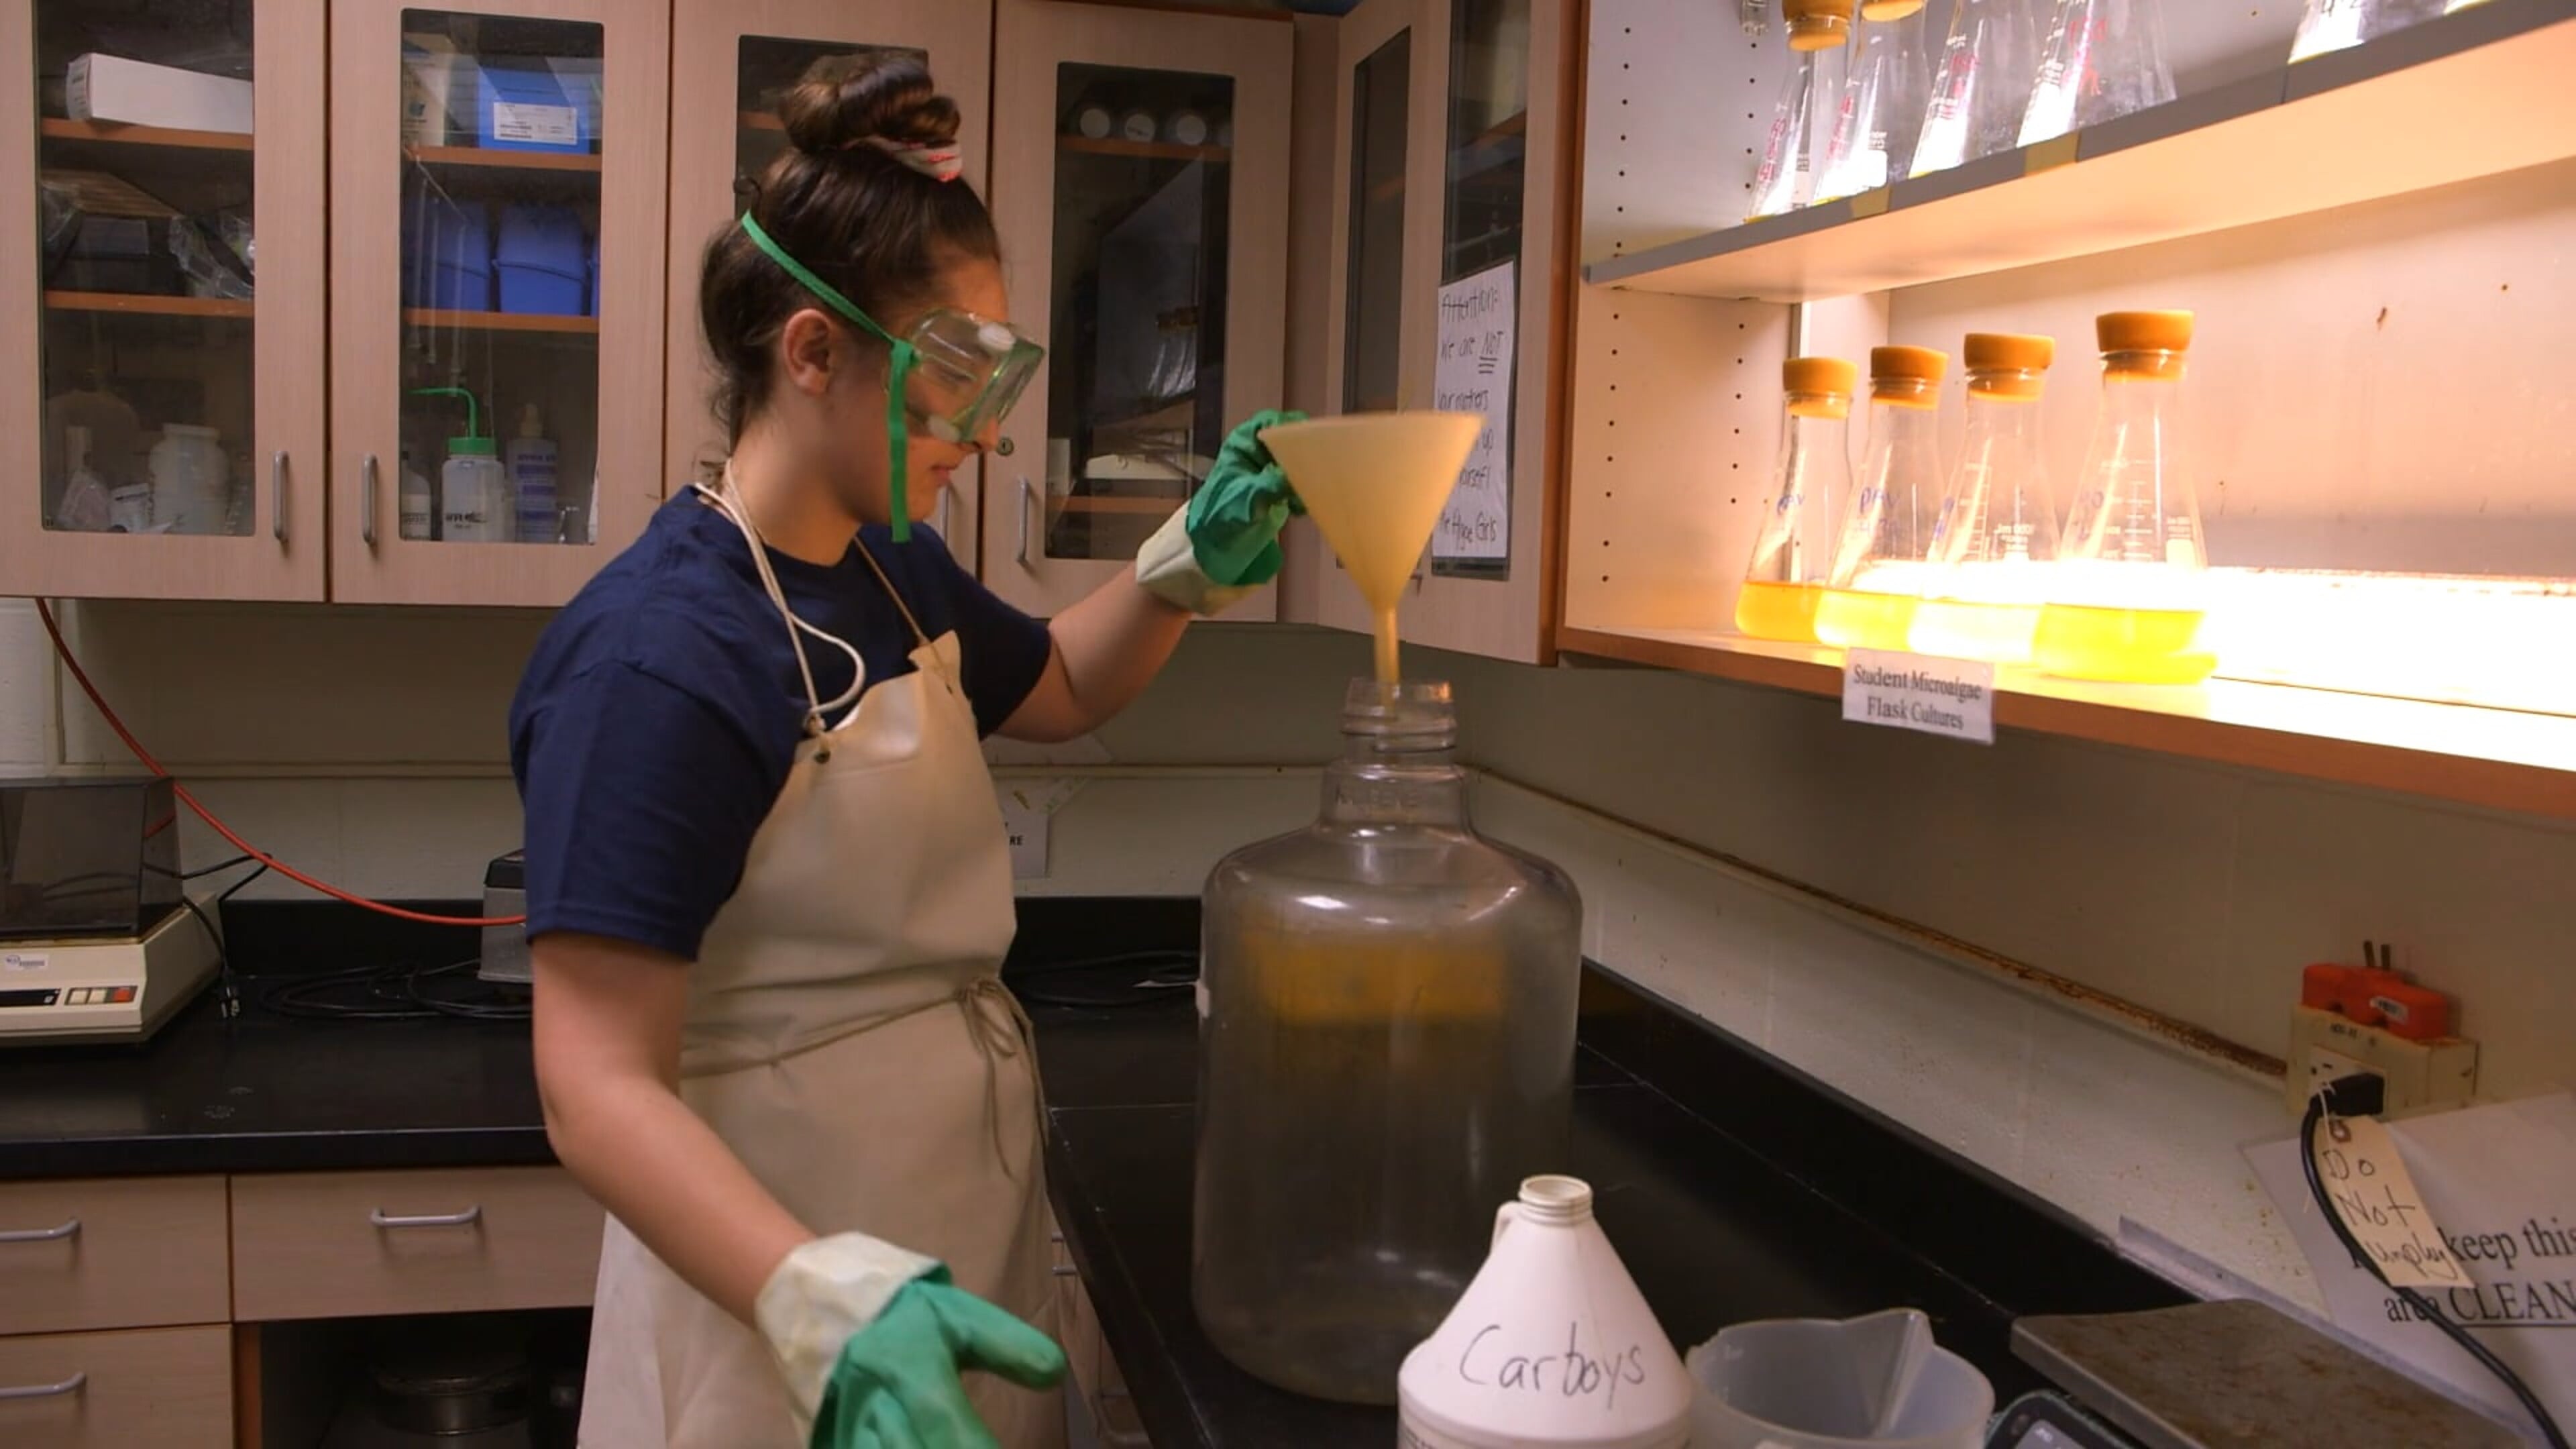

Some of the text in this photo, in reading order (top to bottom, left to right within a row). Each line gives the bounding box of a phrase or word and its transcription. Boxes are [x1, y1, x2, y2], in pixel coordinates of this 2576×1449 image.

[1853, 663, 1982, 704] Student Microalgae
[1866, 695, 1964, 730] Flask Cultures
[2322, 1148, 2375, 1181] Do
[2334, 1183, 2416, 1228] Not
[2436, 1226, 2518, 1270] keep
[2449, 1279, 2576, 1321] CLEAN
[1458, 1320, 1646, 1409] Carboys
